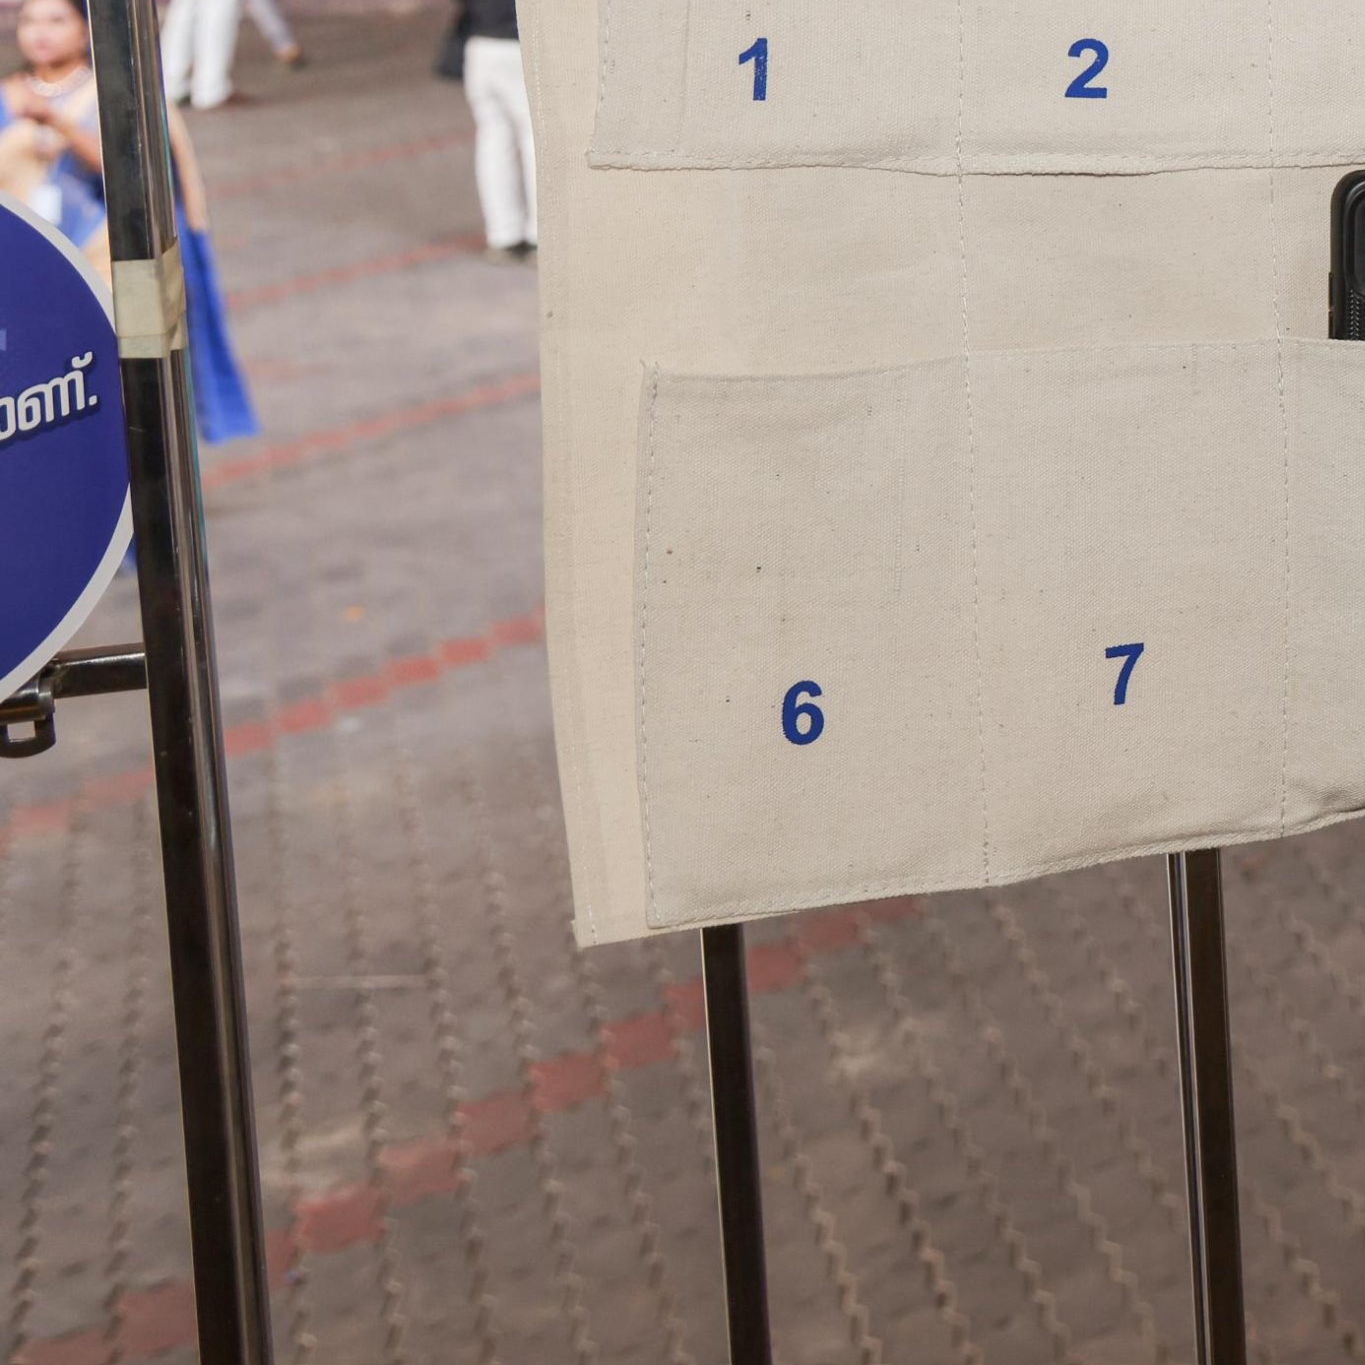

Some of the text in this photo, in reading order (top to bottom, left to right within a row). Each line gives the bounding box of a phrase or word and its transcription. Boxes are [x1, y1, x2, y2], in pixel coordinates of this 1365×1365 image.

[739, 38, 768, 101] 1
[1066, 38, 1109, 99] 2
[1106, 644, 1144, 705] 7
[783, 681, 824, 745] 6
